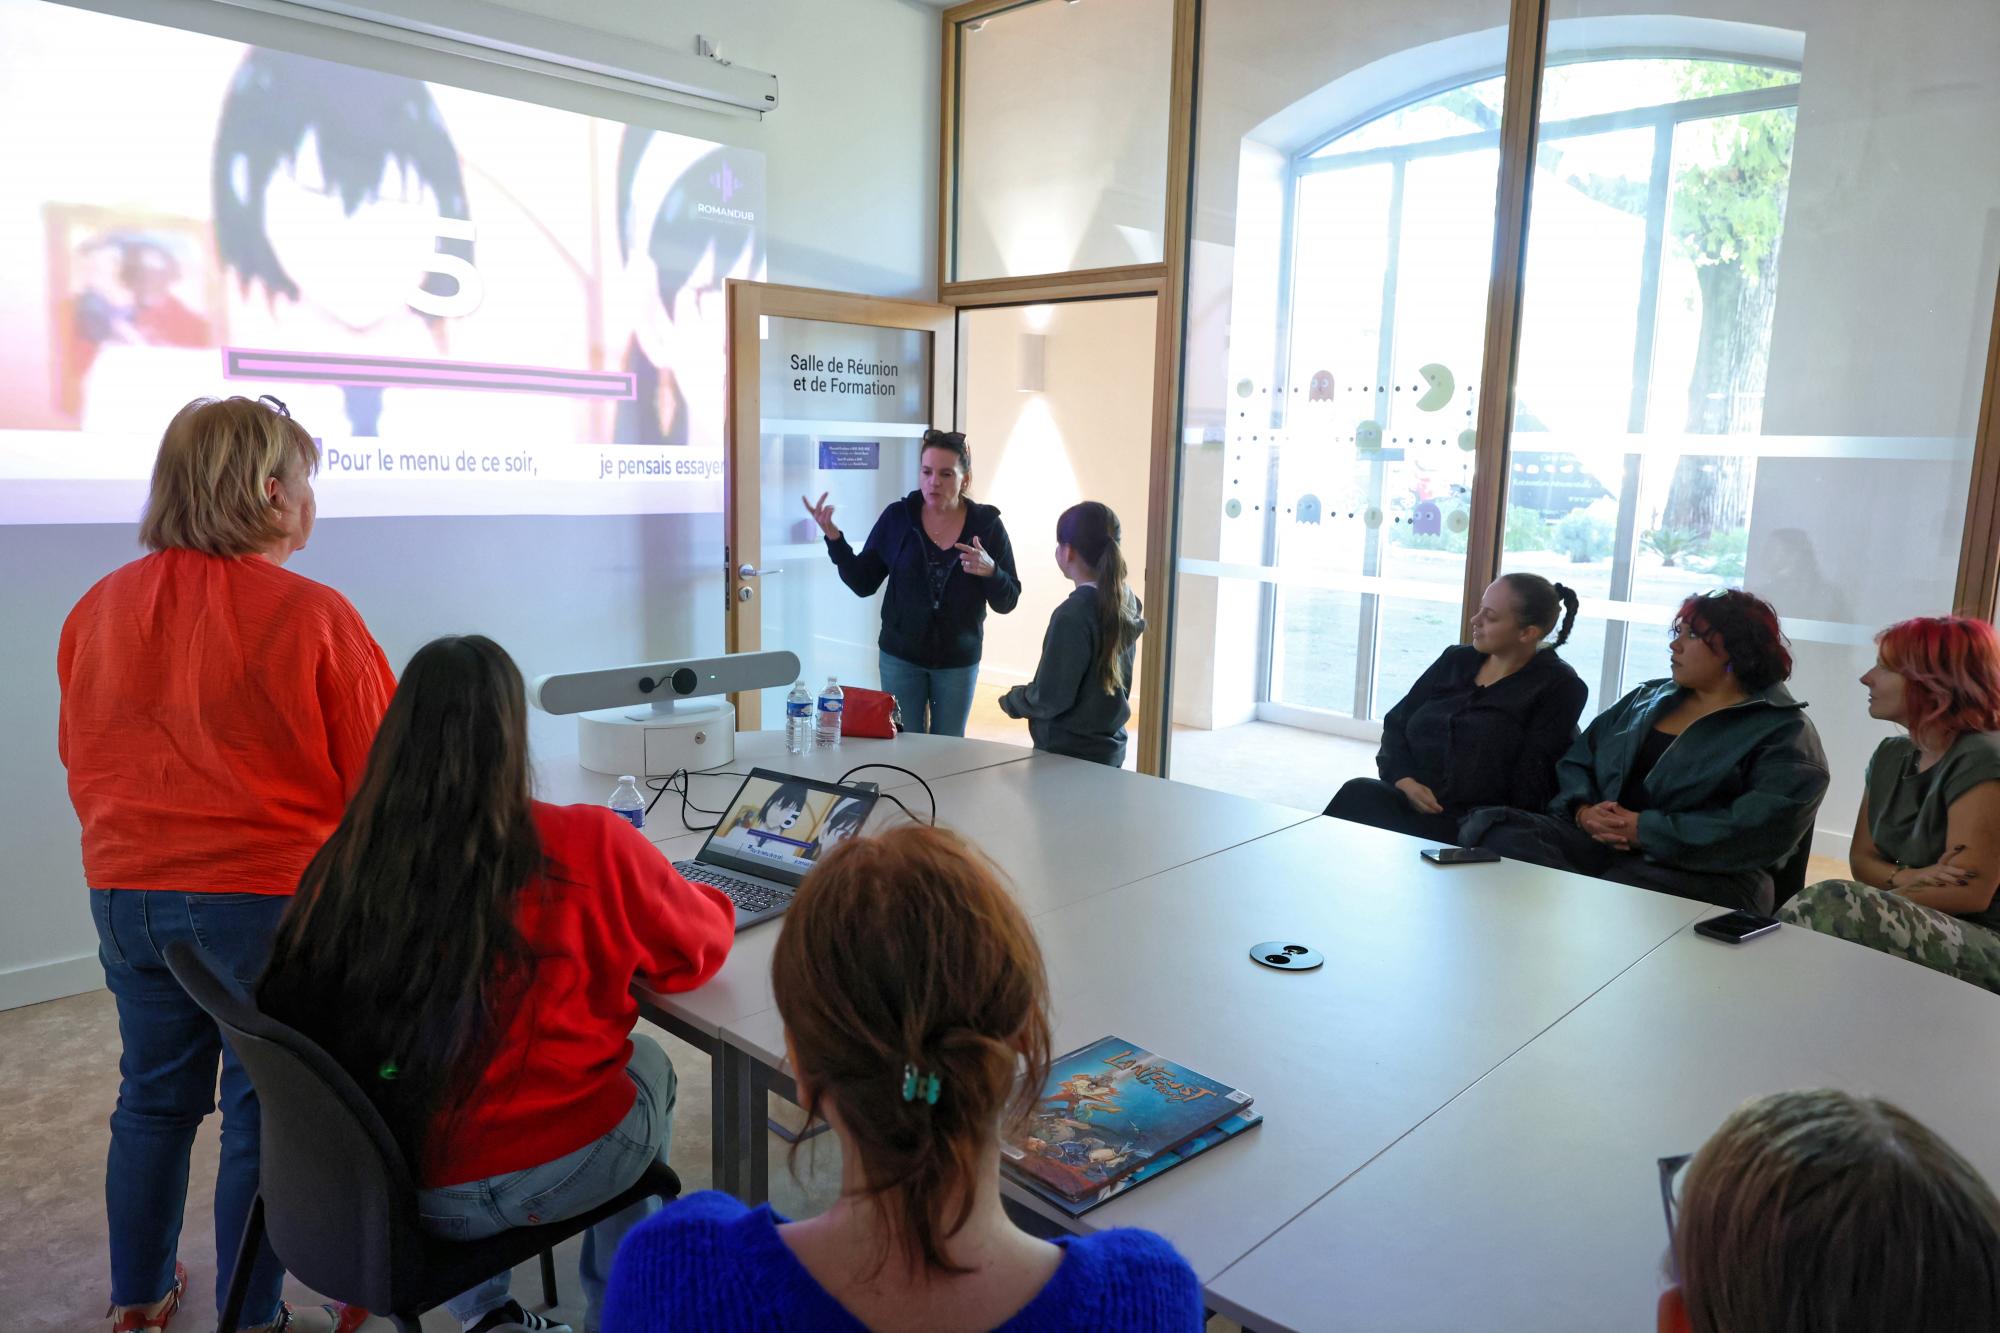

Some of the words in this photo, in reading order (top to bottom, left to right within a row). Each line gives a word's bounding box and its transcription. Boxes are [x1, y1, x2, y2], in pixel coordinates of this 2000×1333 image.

[698, 203, 754, 221] ROMANDUB
[403, 217, 484, 318] 5
[790, 354, 824, 372] Salle
[827, 356, 844, 373] de
[847, 358, 898, 377] Réunion
[793, 376, 807, 391] et
[810, 376, 827, 392] de
[831, 377, 896, 396] Formation
[327, 448, 372, 471] Pour
[378, 448, 394, 471] le
[399, 453, 450, 472] menu
[455, 449, 477, 472] de
[481, 455, 500, 472] ce
[505, 449, 538, 476] soir,
[598, 453, 613, 479] je
[618, 454, 672, 480] pensais
